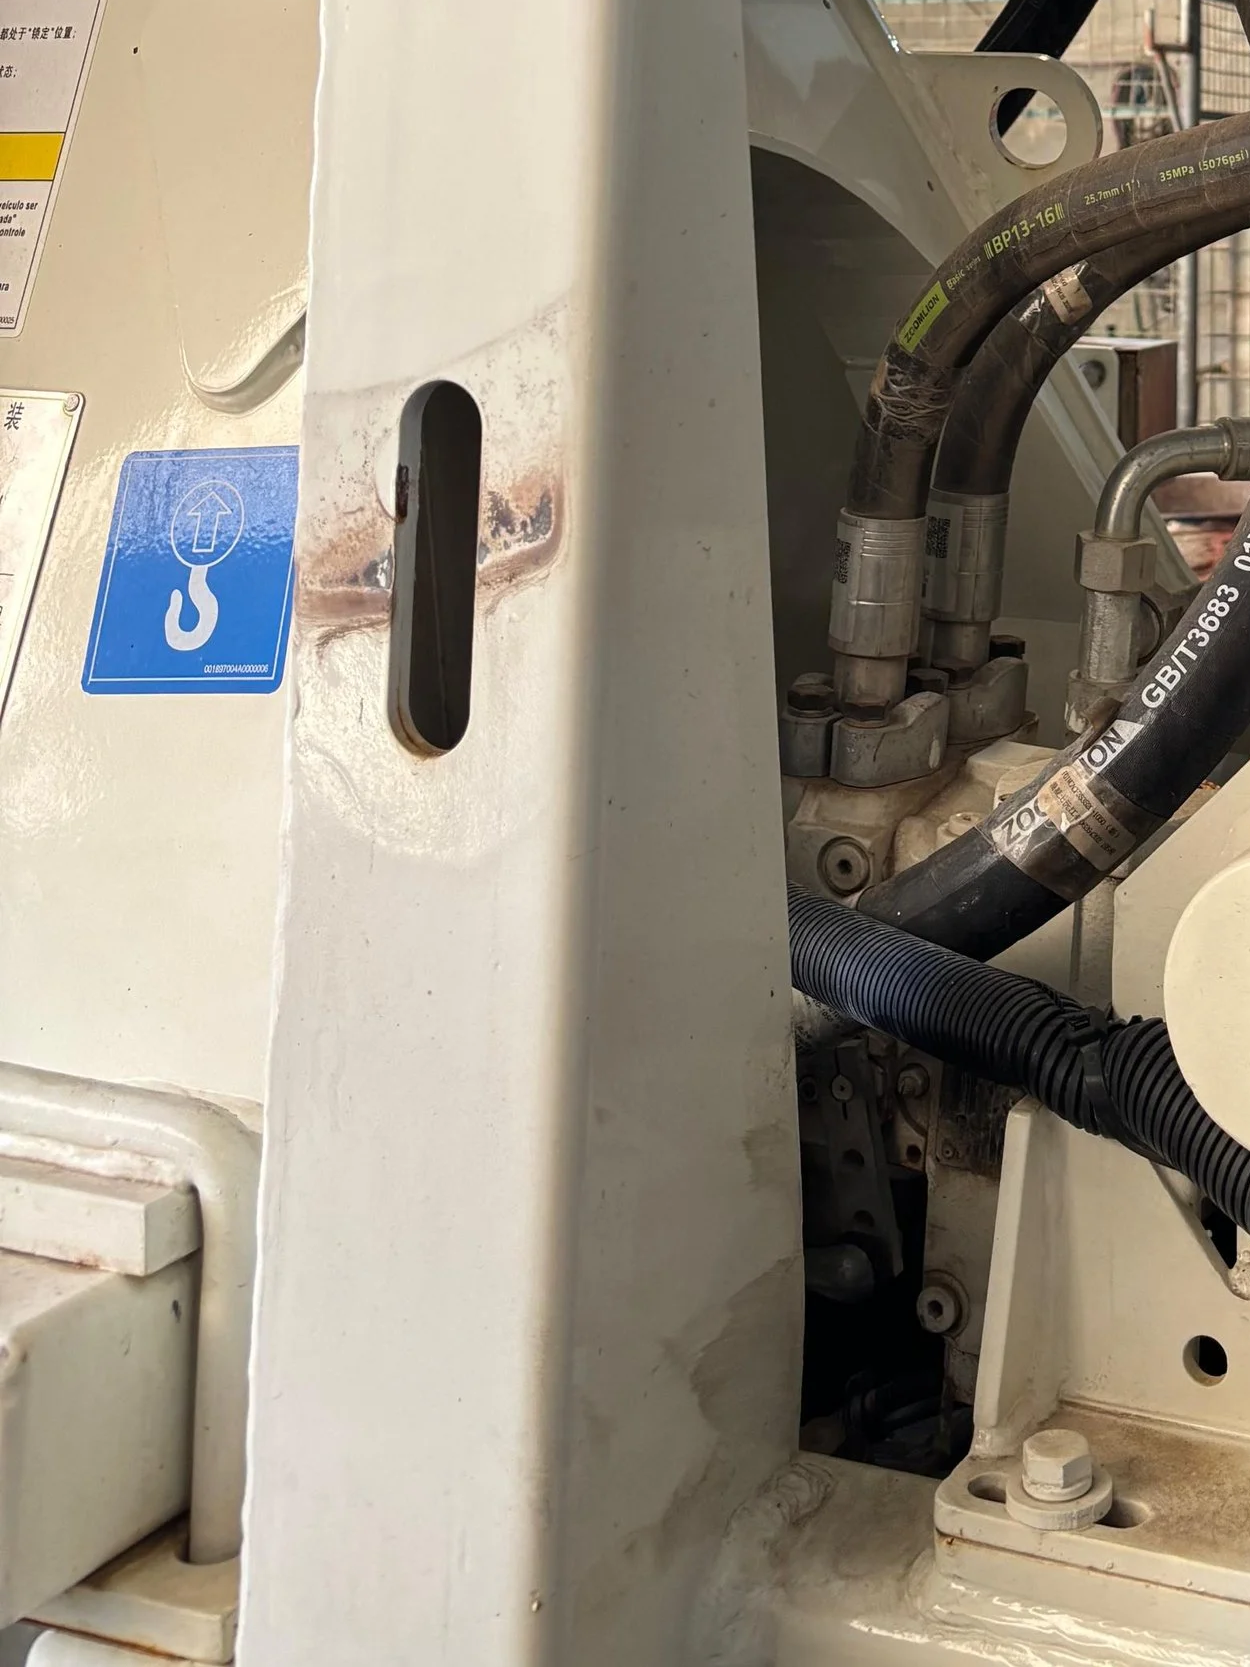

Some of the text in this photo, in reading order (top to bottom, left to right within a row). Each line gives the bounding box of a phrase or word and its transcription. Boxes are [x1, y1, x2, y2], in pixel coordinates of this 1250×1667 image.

[25, 202, 39, 211] ser
[902, 293, 941, 344] ZOOMLION
[946, 269, 966, 290] Basic
[991, 205, 1056, 256] BP13-16
[1158, 165, 1196, 183] 35MPa
[1198, 150, 1250, 172] (5076psi)
[1140, 582, 1240, 710] GB/T3683
